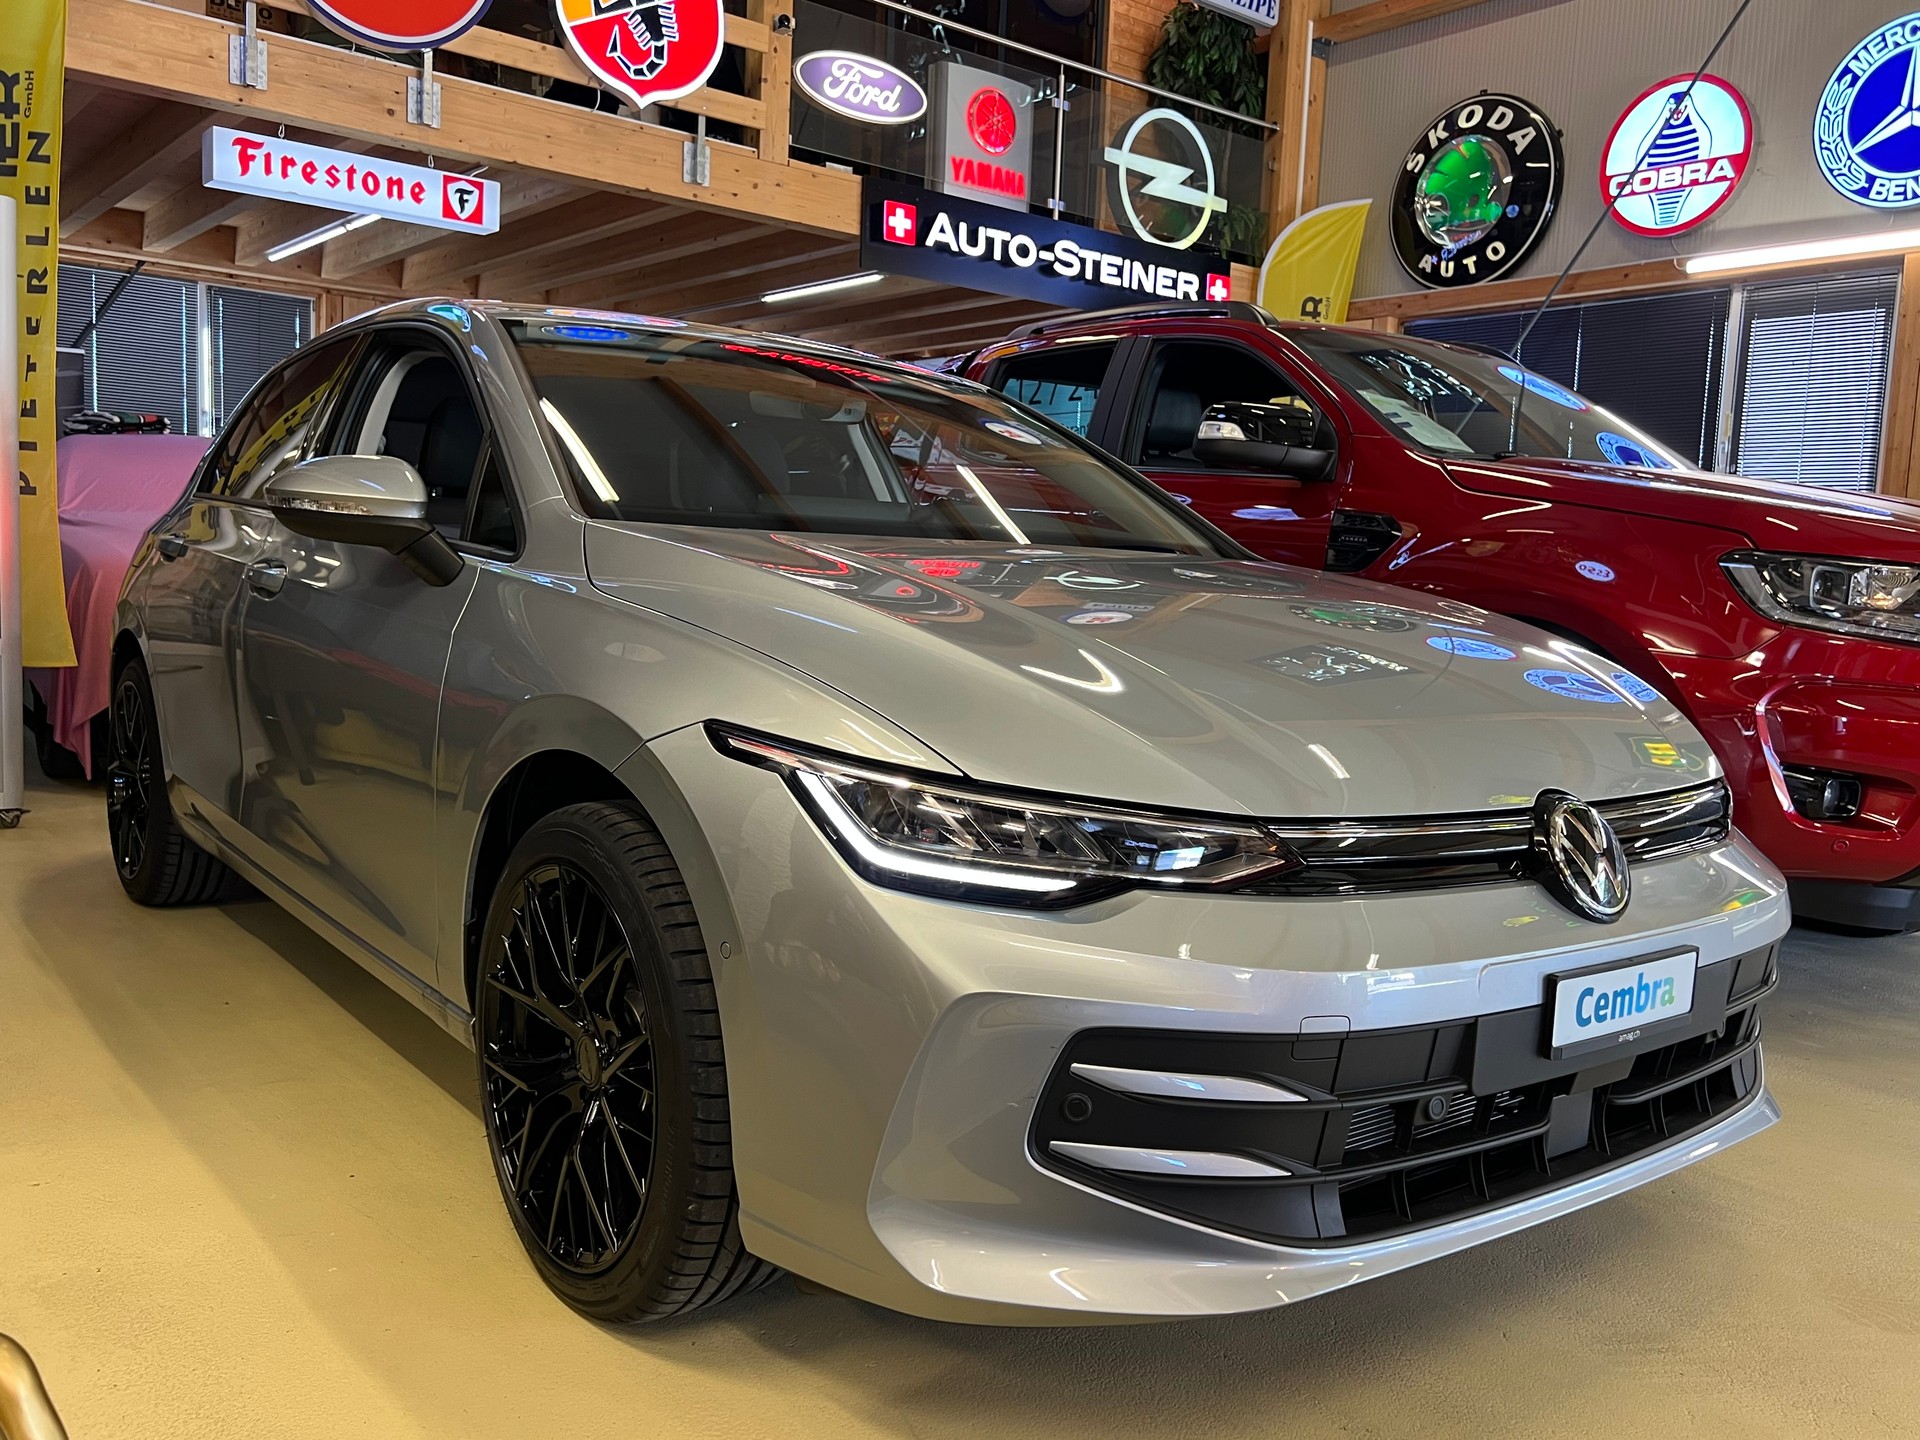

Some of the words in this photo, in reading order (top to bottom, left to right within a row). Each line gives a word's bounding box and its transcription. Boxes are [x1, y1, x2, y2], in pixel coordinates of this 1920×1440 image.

[24, 70, 35, 119] GmbH
[823, 59, 902, 113] Ford
[231, 136, 427, 205] Firestone
[950, 155, 1026, 199] YAMAHA
[1608, 157, 1736, 197] COBRA
[925, 211, 1201, 302] AUTO-STEINER
[1418, 241, 1506, 278] AUTO
[1575, 972, 1676, 1028] Cembra
[1618, 1029, 1641, 1043] amag.ch
